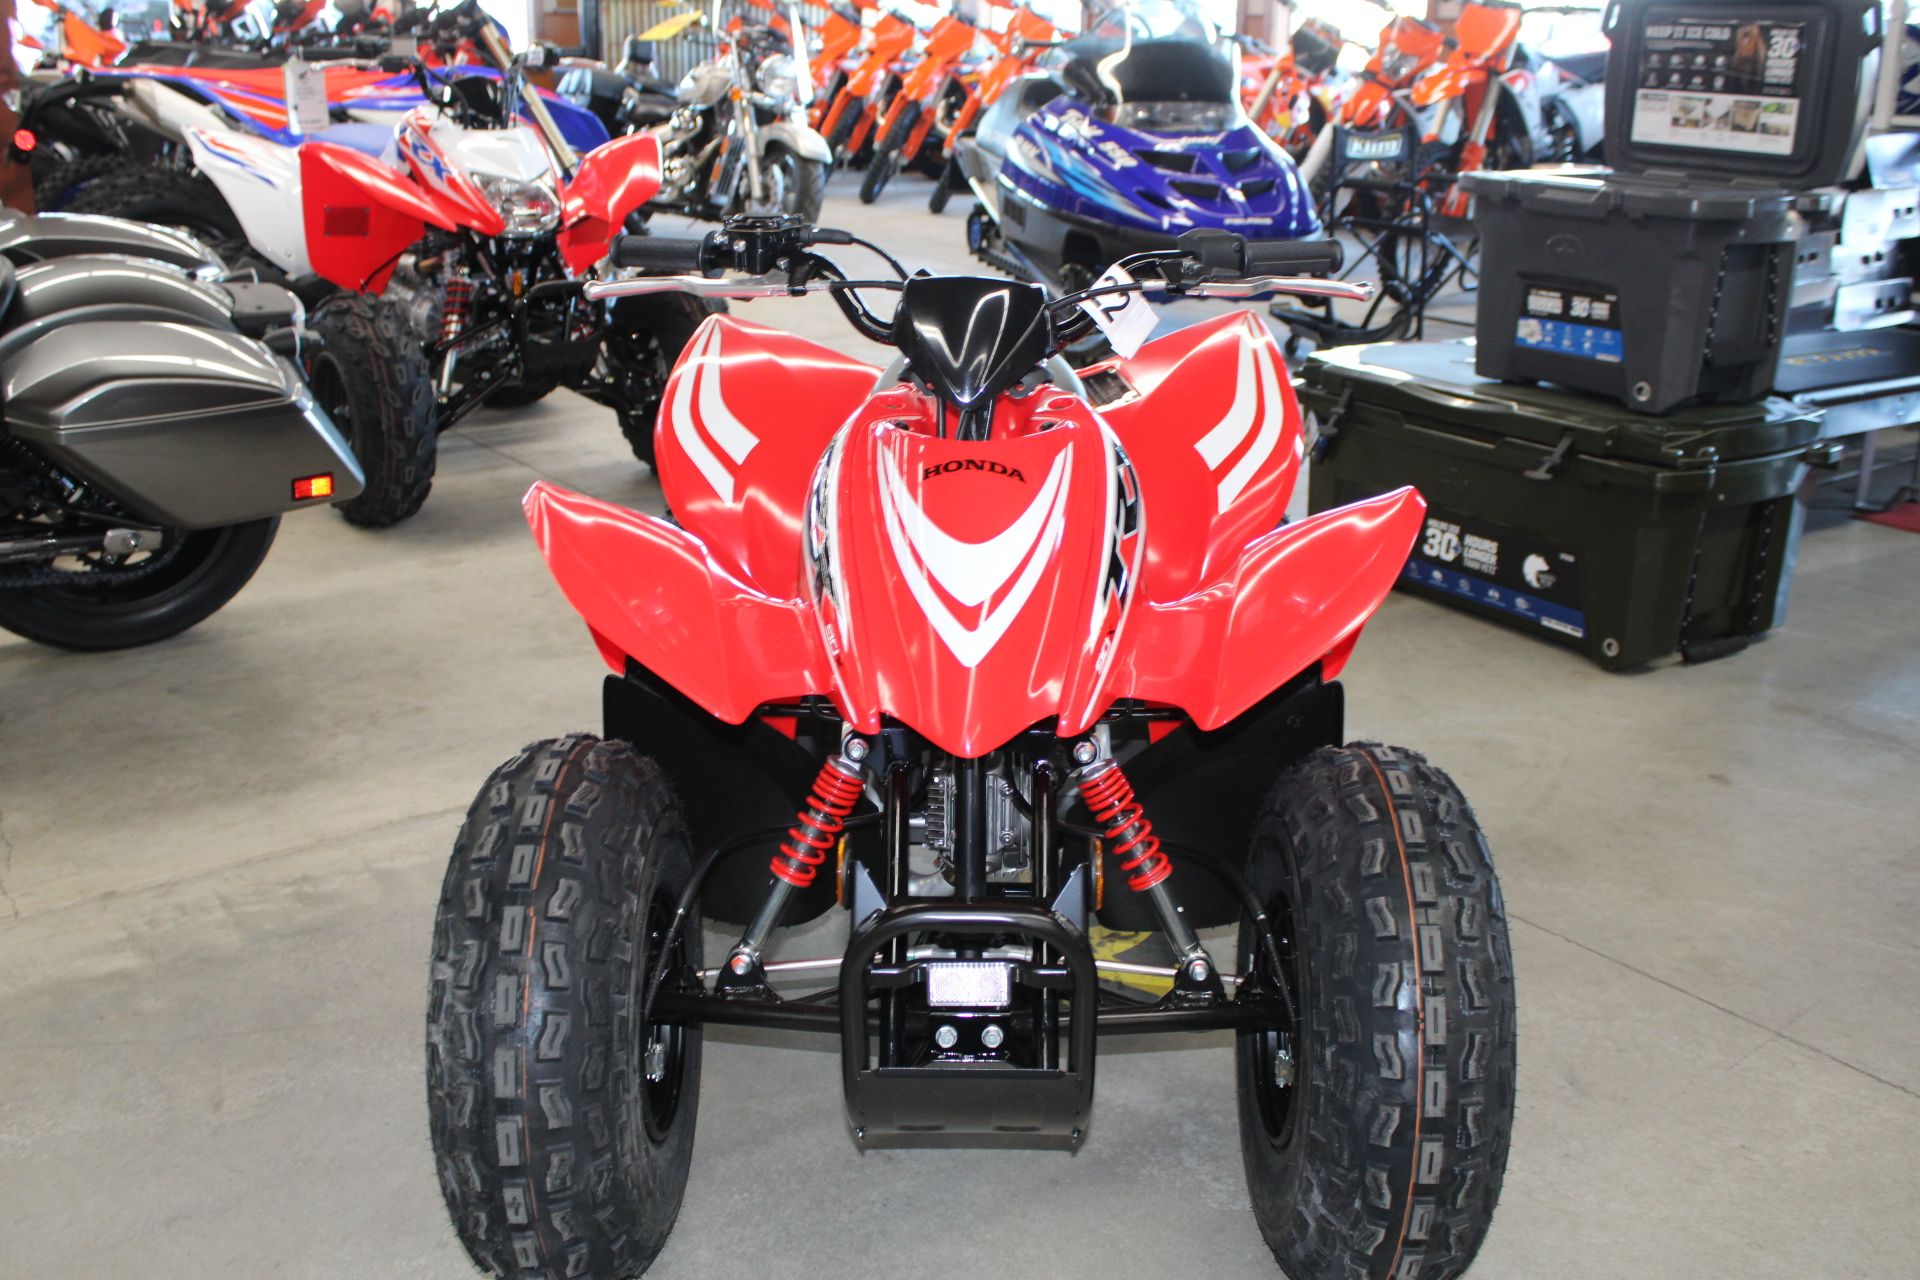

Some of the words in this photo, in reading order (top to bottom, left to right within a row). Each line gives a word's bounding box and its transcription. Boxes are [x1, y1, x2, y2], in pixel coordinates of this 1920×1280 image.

[922, 459, 1027, 484] HONDA
[1463, 533, 1499, 554] HOURS
[1463, 547, 1498, 567] LONGER
